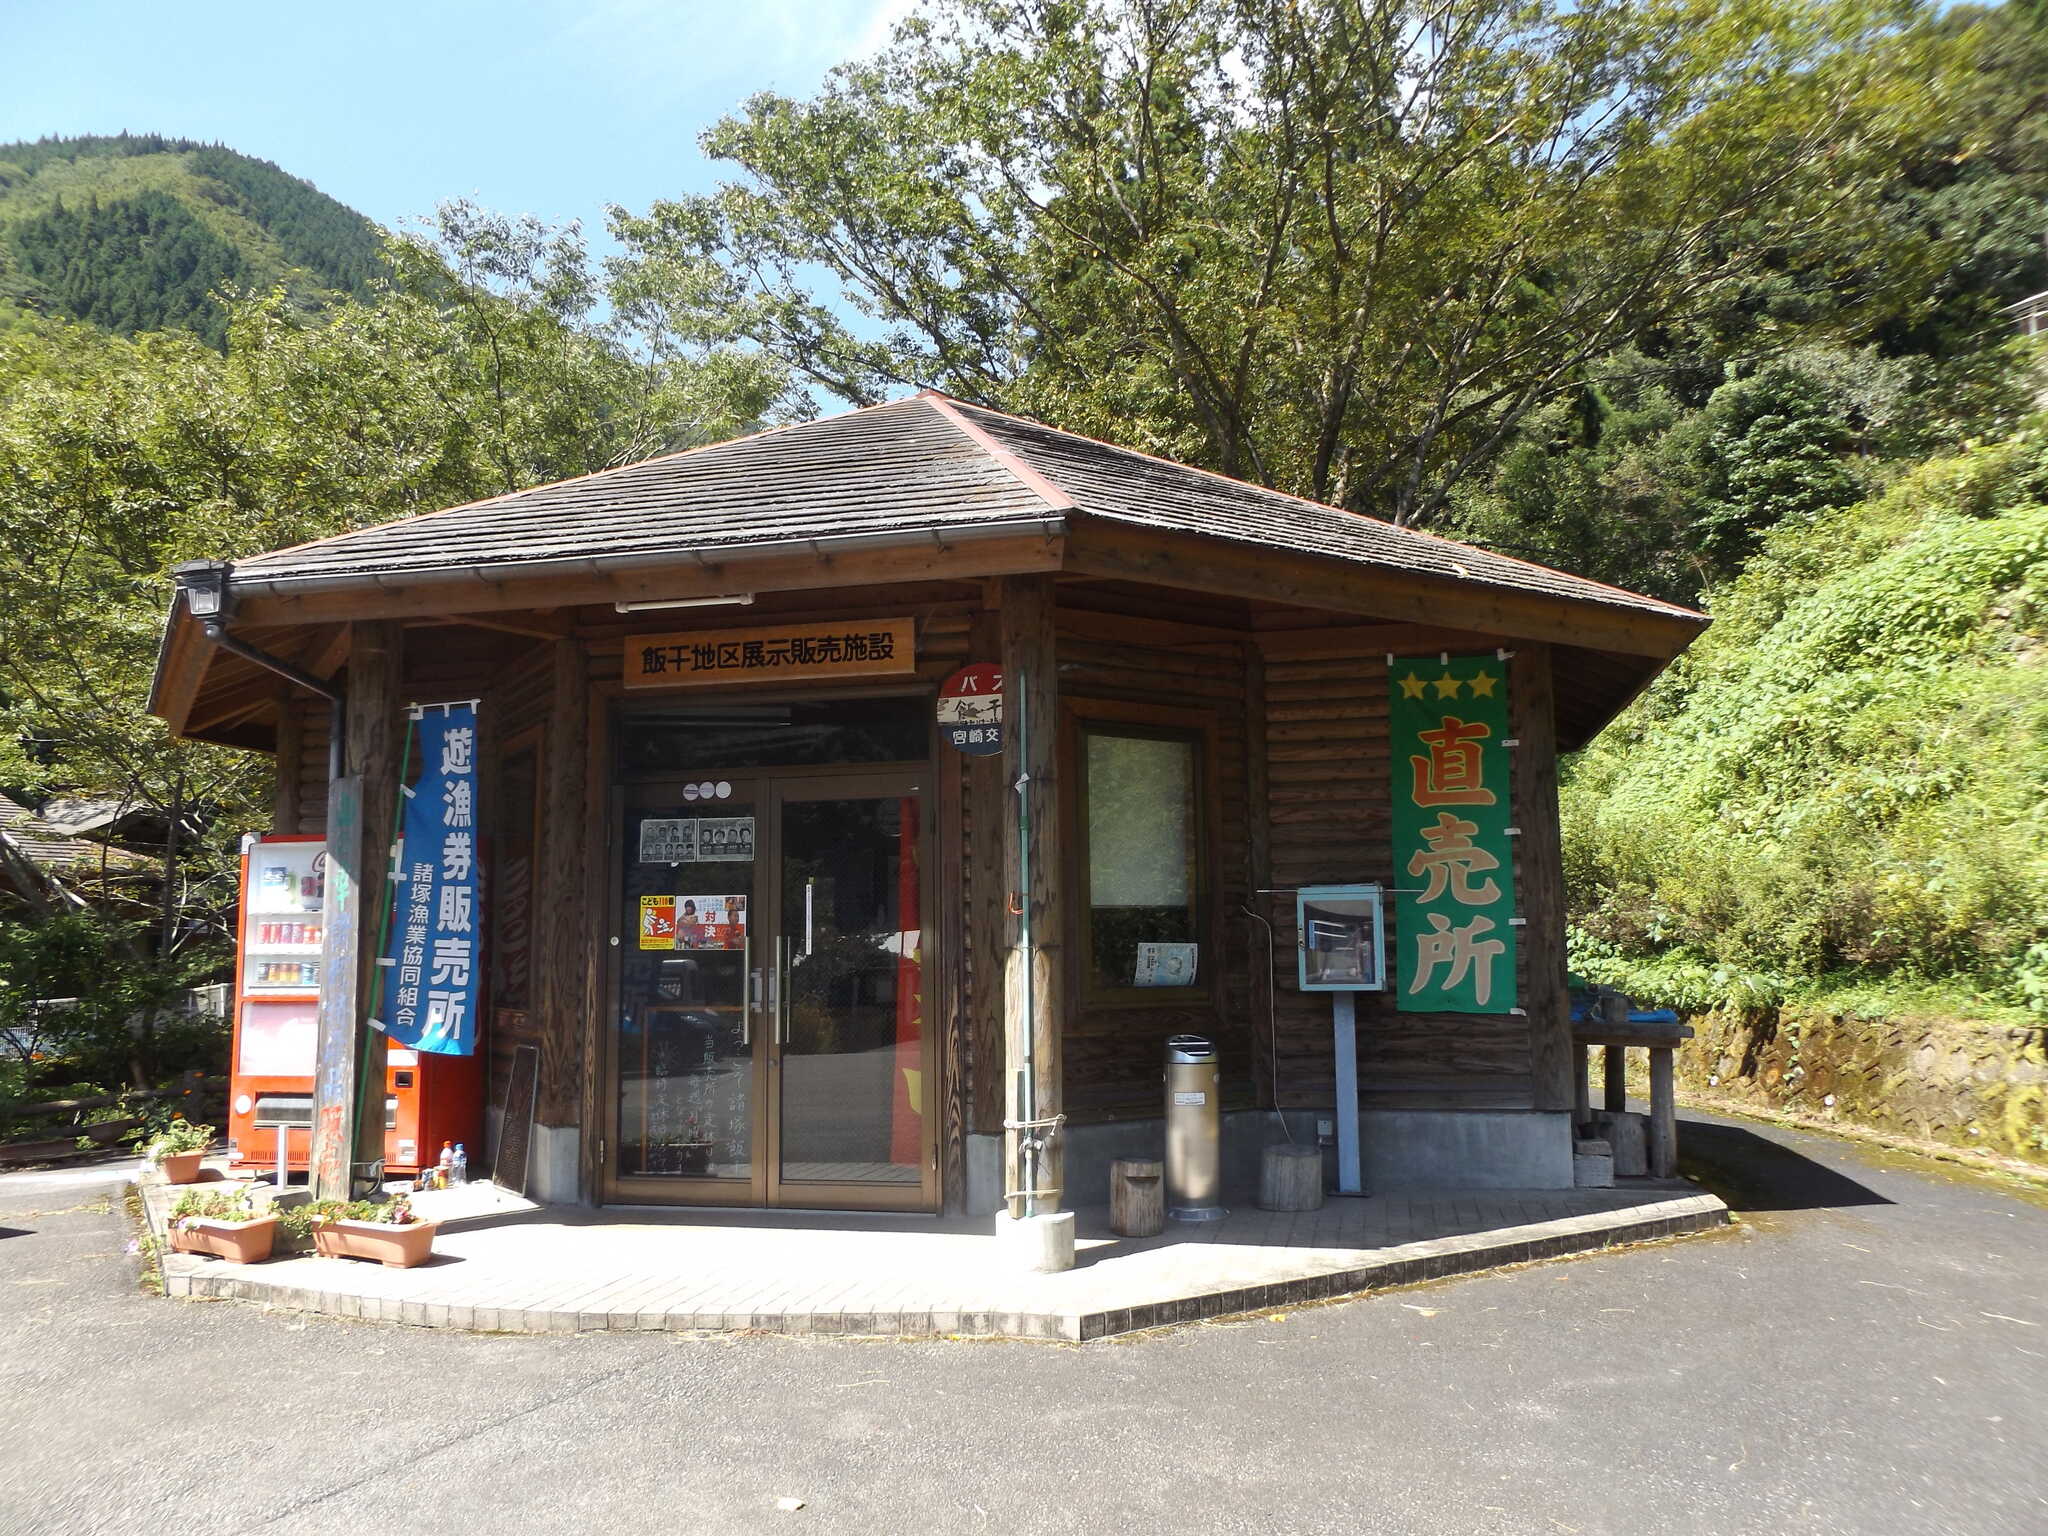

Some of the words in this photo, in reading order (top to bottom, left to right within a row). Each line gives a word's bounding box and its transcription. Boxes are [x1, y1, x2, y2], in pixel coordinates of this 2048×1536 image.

[641, 632, 894, 674] 飯干地区展示販売施設
[960, 675, 1002, 692] バス
[952, 728, 999, 744] 宮崎交
[421, 727, 472, 1040] 遊漁券販売所
[1407, 715, 1506, 1006] 直売所
[396, 862, 434, 1027] 諸塚漁業協同組合
